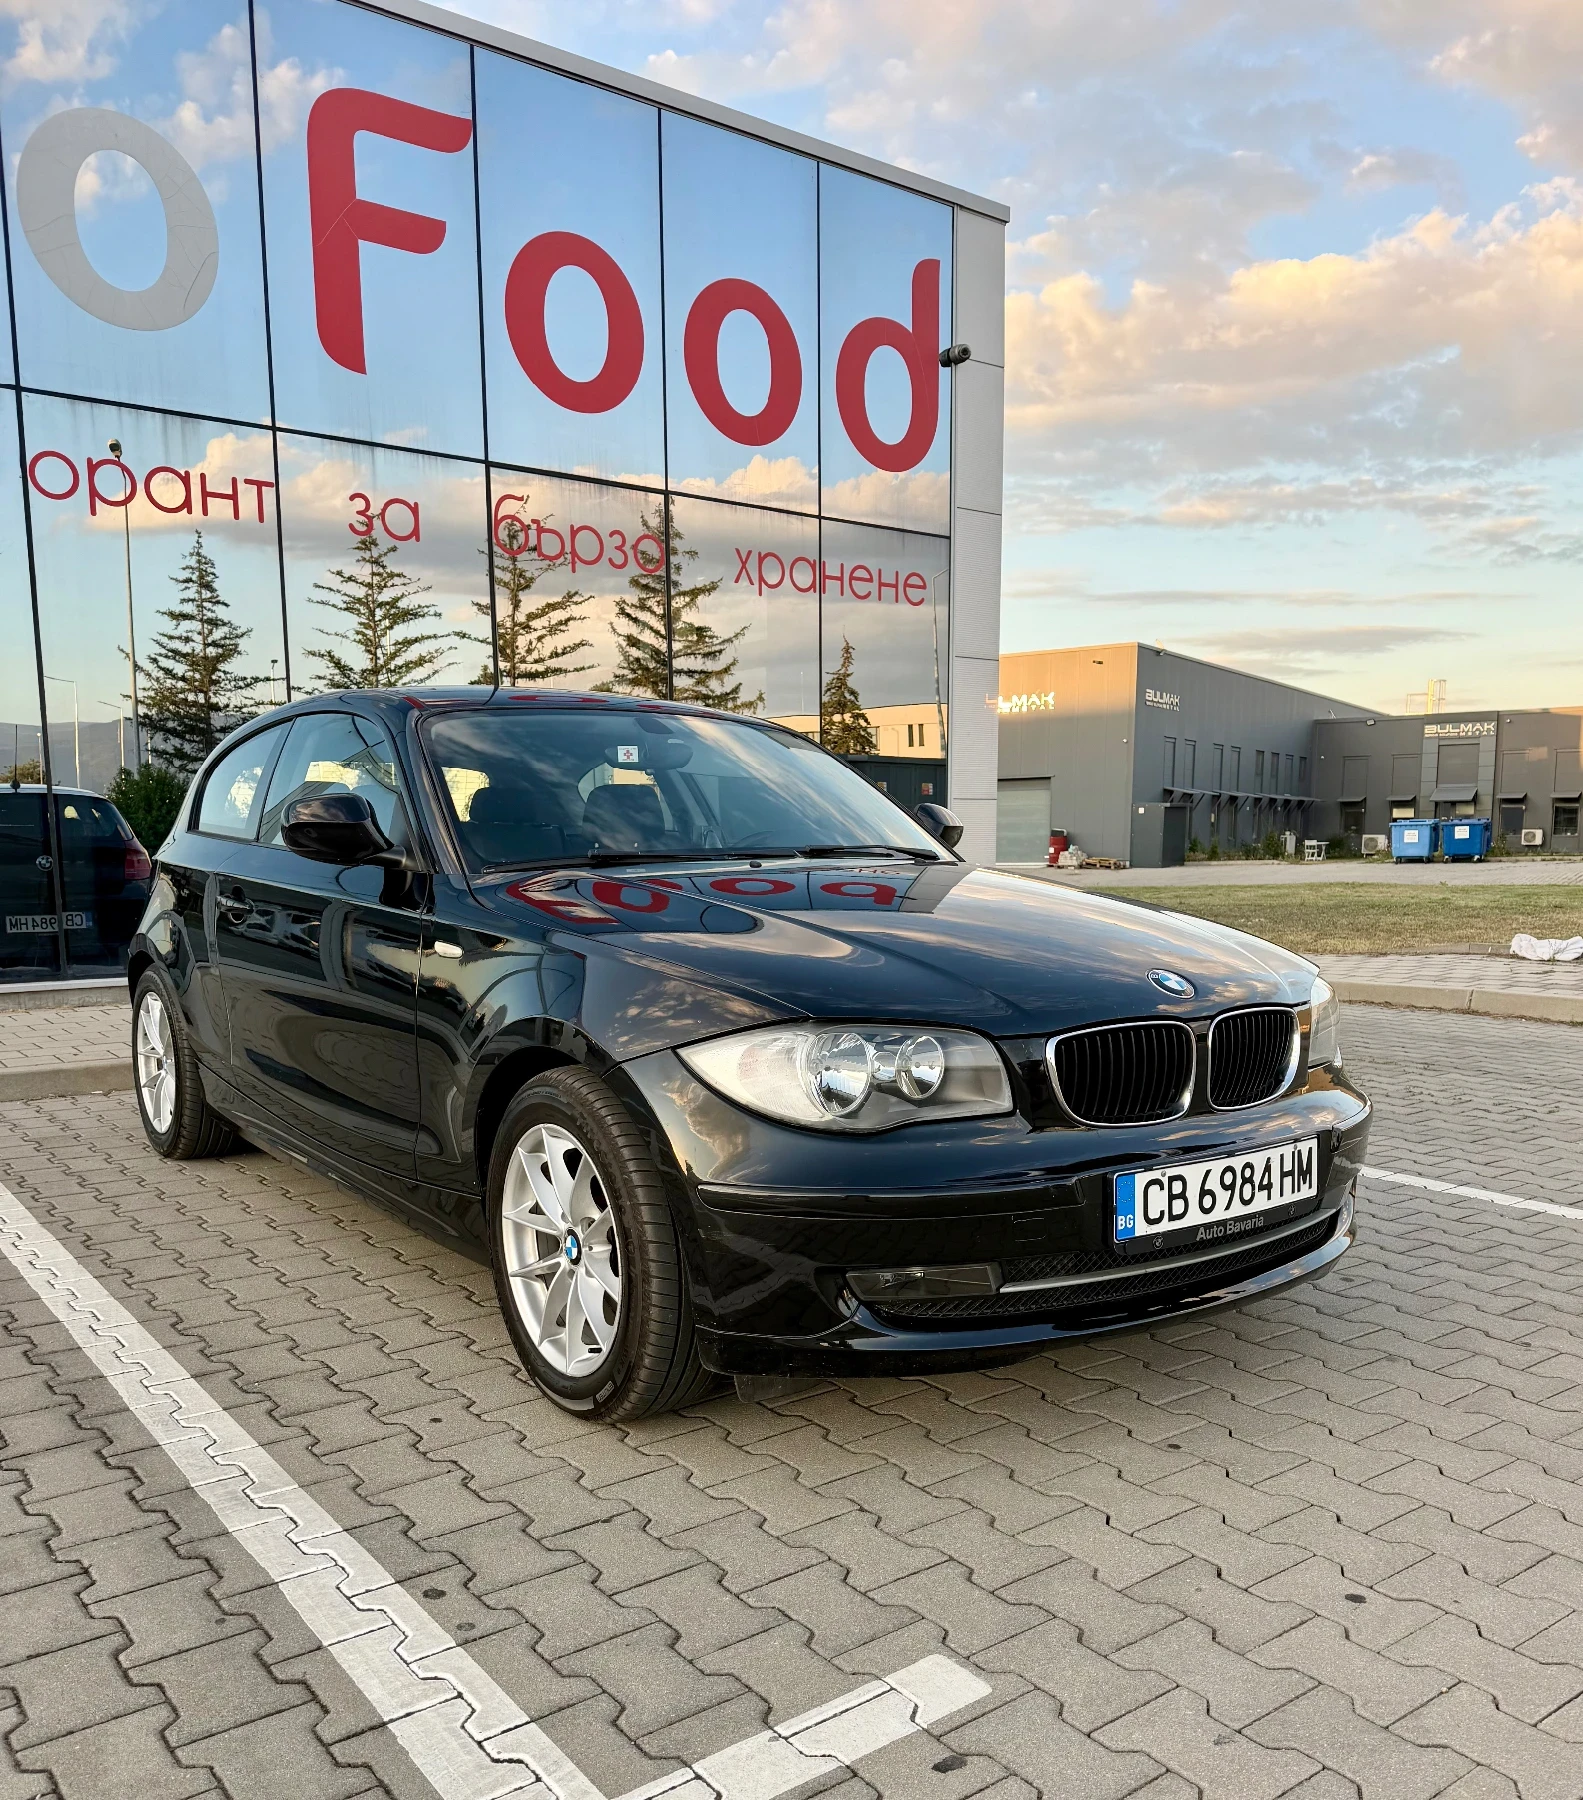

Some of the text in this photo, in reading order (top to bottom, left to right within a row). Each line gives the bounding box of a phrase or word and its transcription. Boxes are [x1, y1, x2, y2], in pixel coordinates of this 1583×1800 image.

[28, 449, 928, 607] орант за бързо хранене
[997, 691, 1055, 708] LMAK
[1145, 688, 1180, 706] BULMAK
[1424, 722, 1495, 734] BULMAK
[1143, 1173, 1190, 1226] CB
[1198, 1156, 1274, 1215] 6984
[1117, 1214, 1134, 1231] BG
[1196, 1214, 1264, 1242] Auto Bavaria
